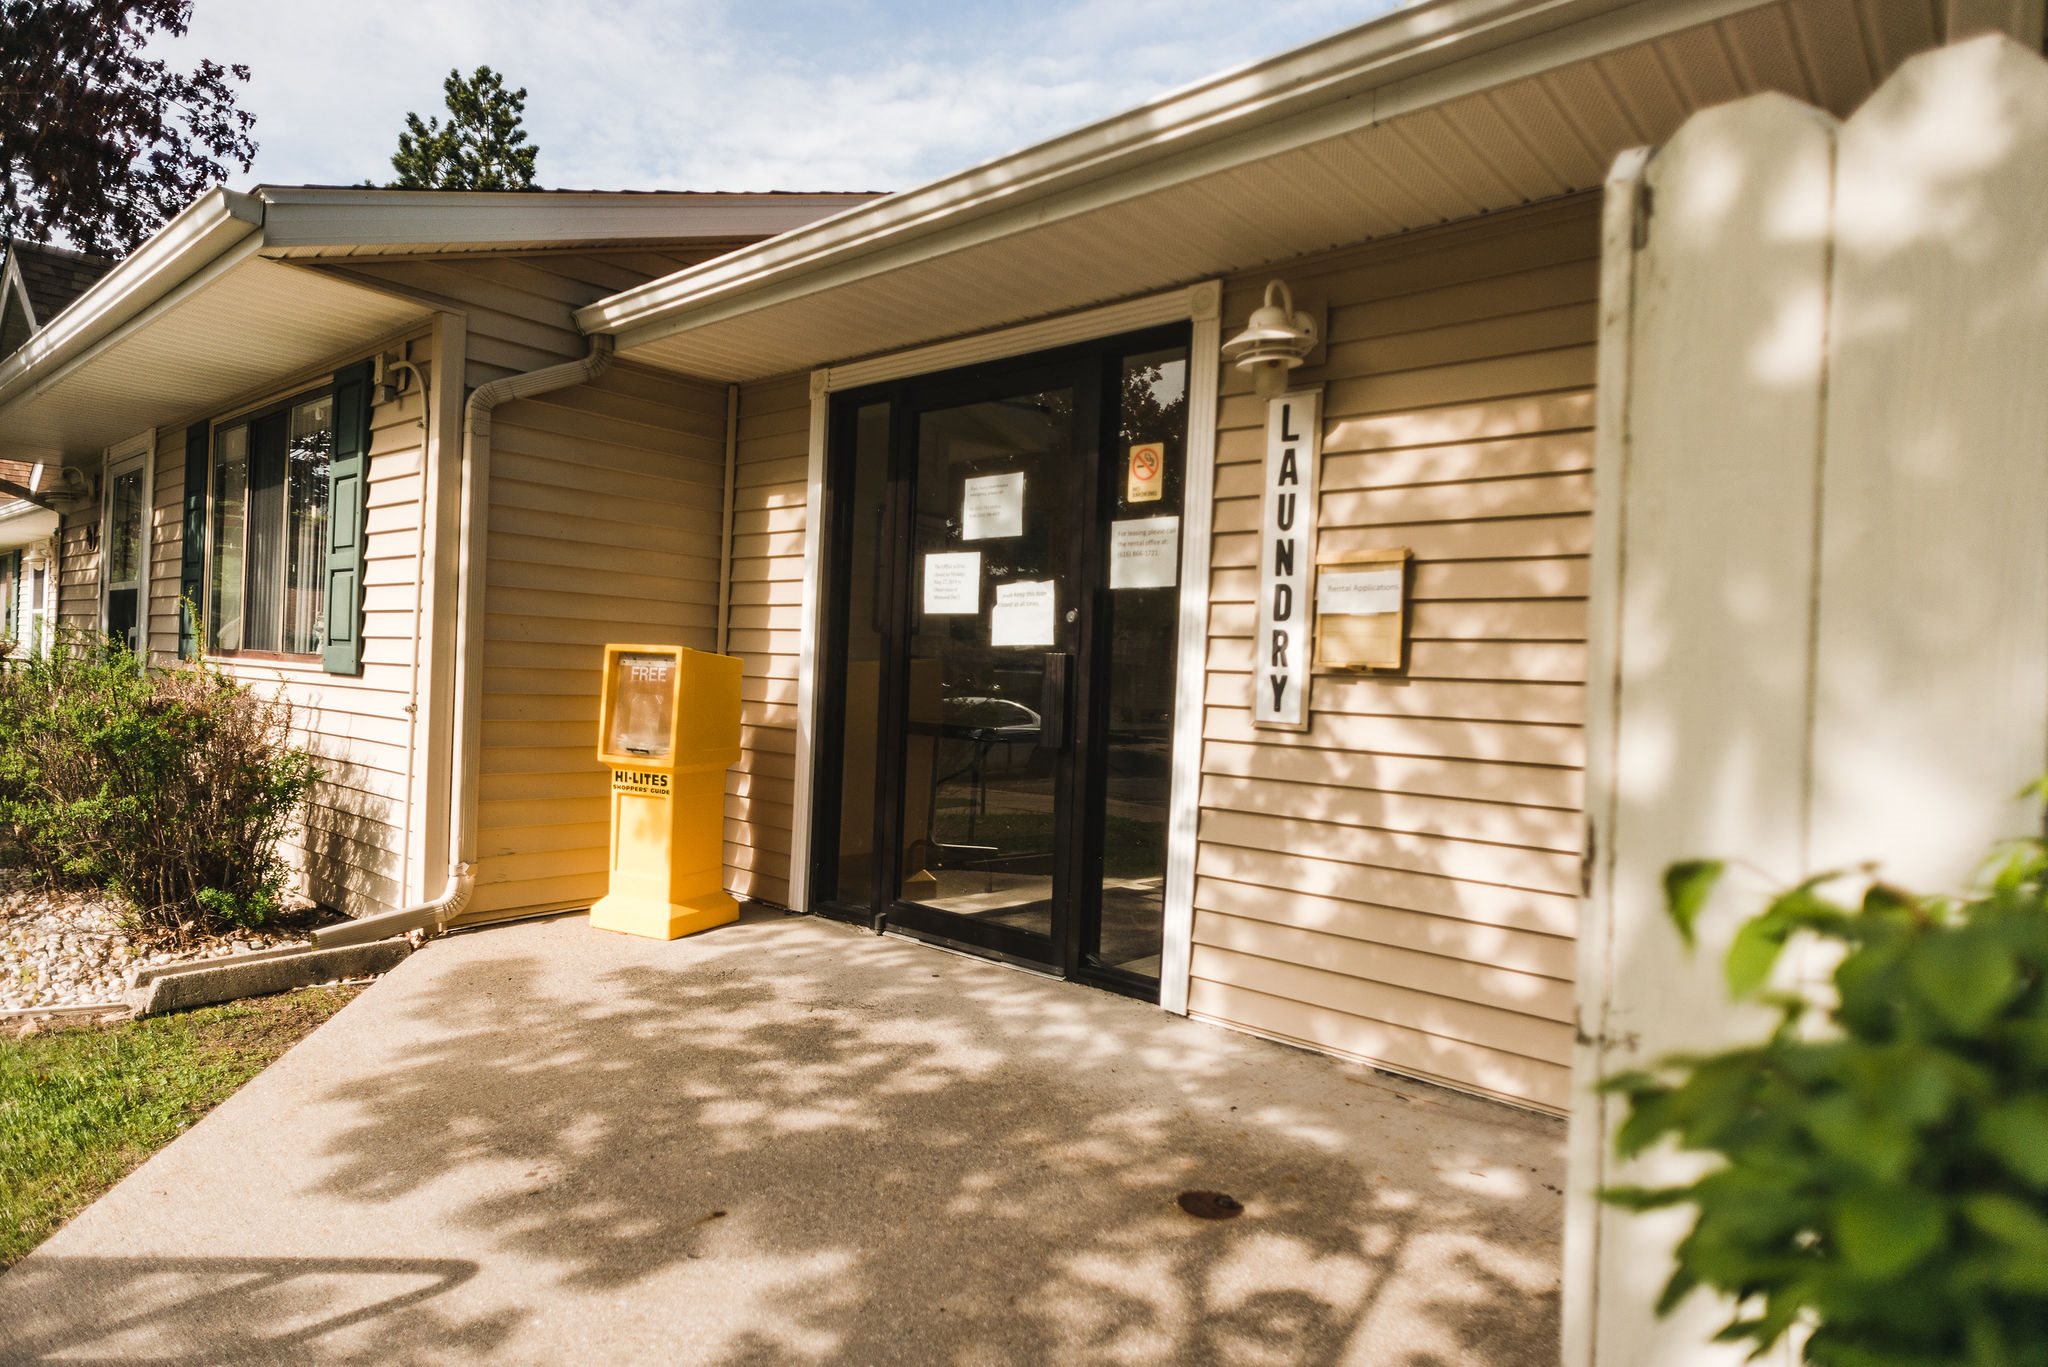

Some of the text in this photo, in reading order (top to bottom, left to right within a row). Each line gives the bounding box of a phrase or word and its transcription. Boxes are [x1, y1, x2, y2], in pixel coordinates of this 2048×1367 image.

[1270, 403, 1300, 713] LAUNDRY
[1327, 583, 1400, 593] Rental Applications
[631, 666, 667, 682] FREE
